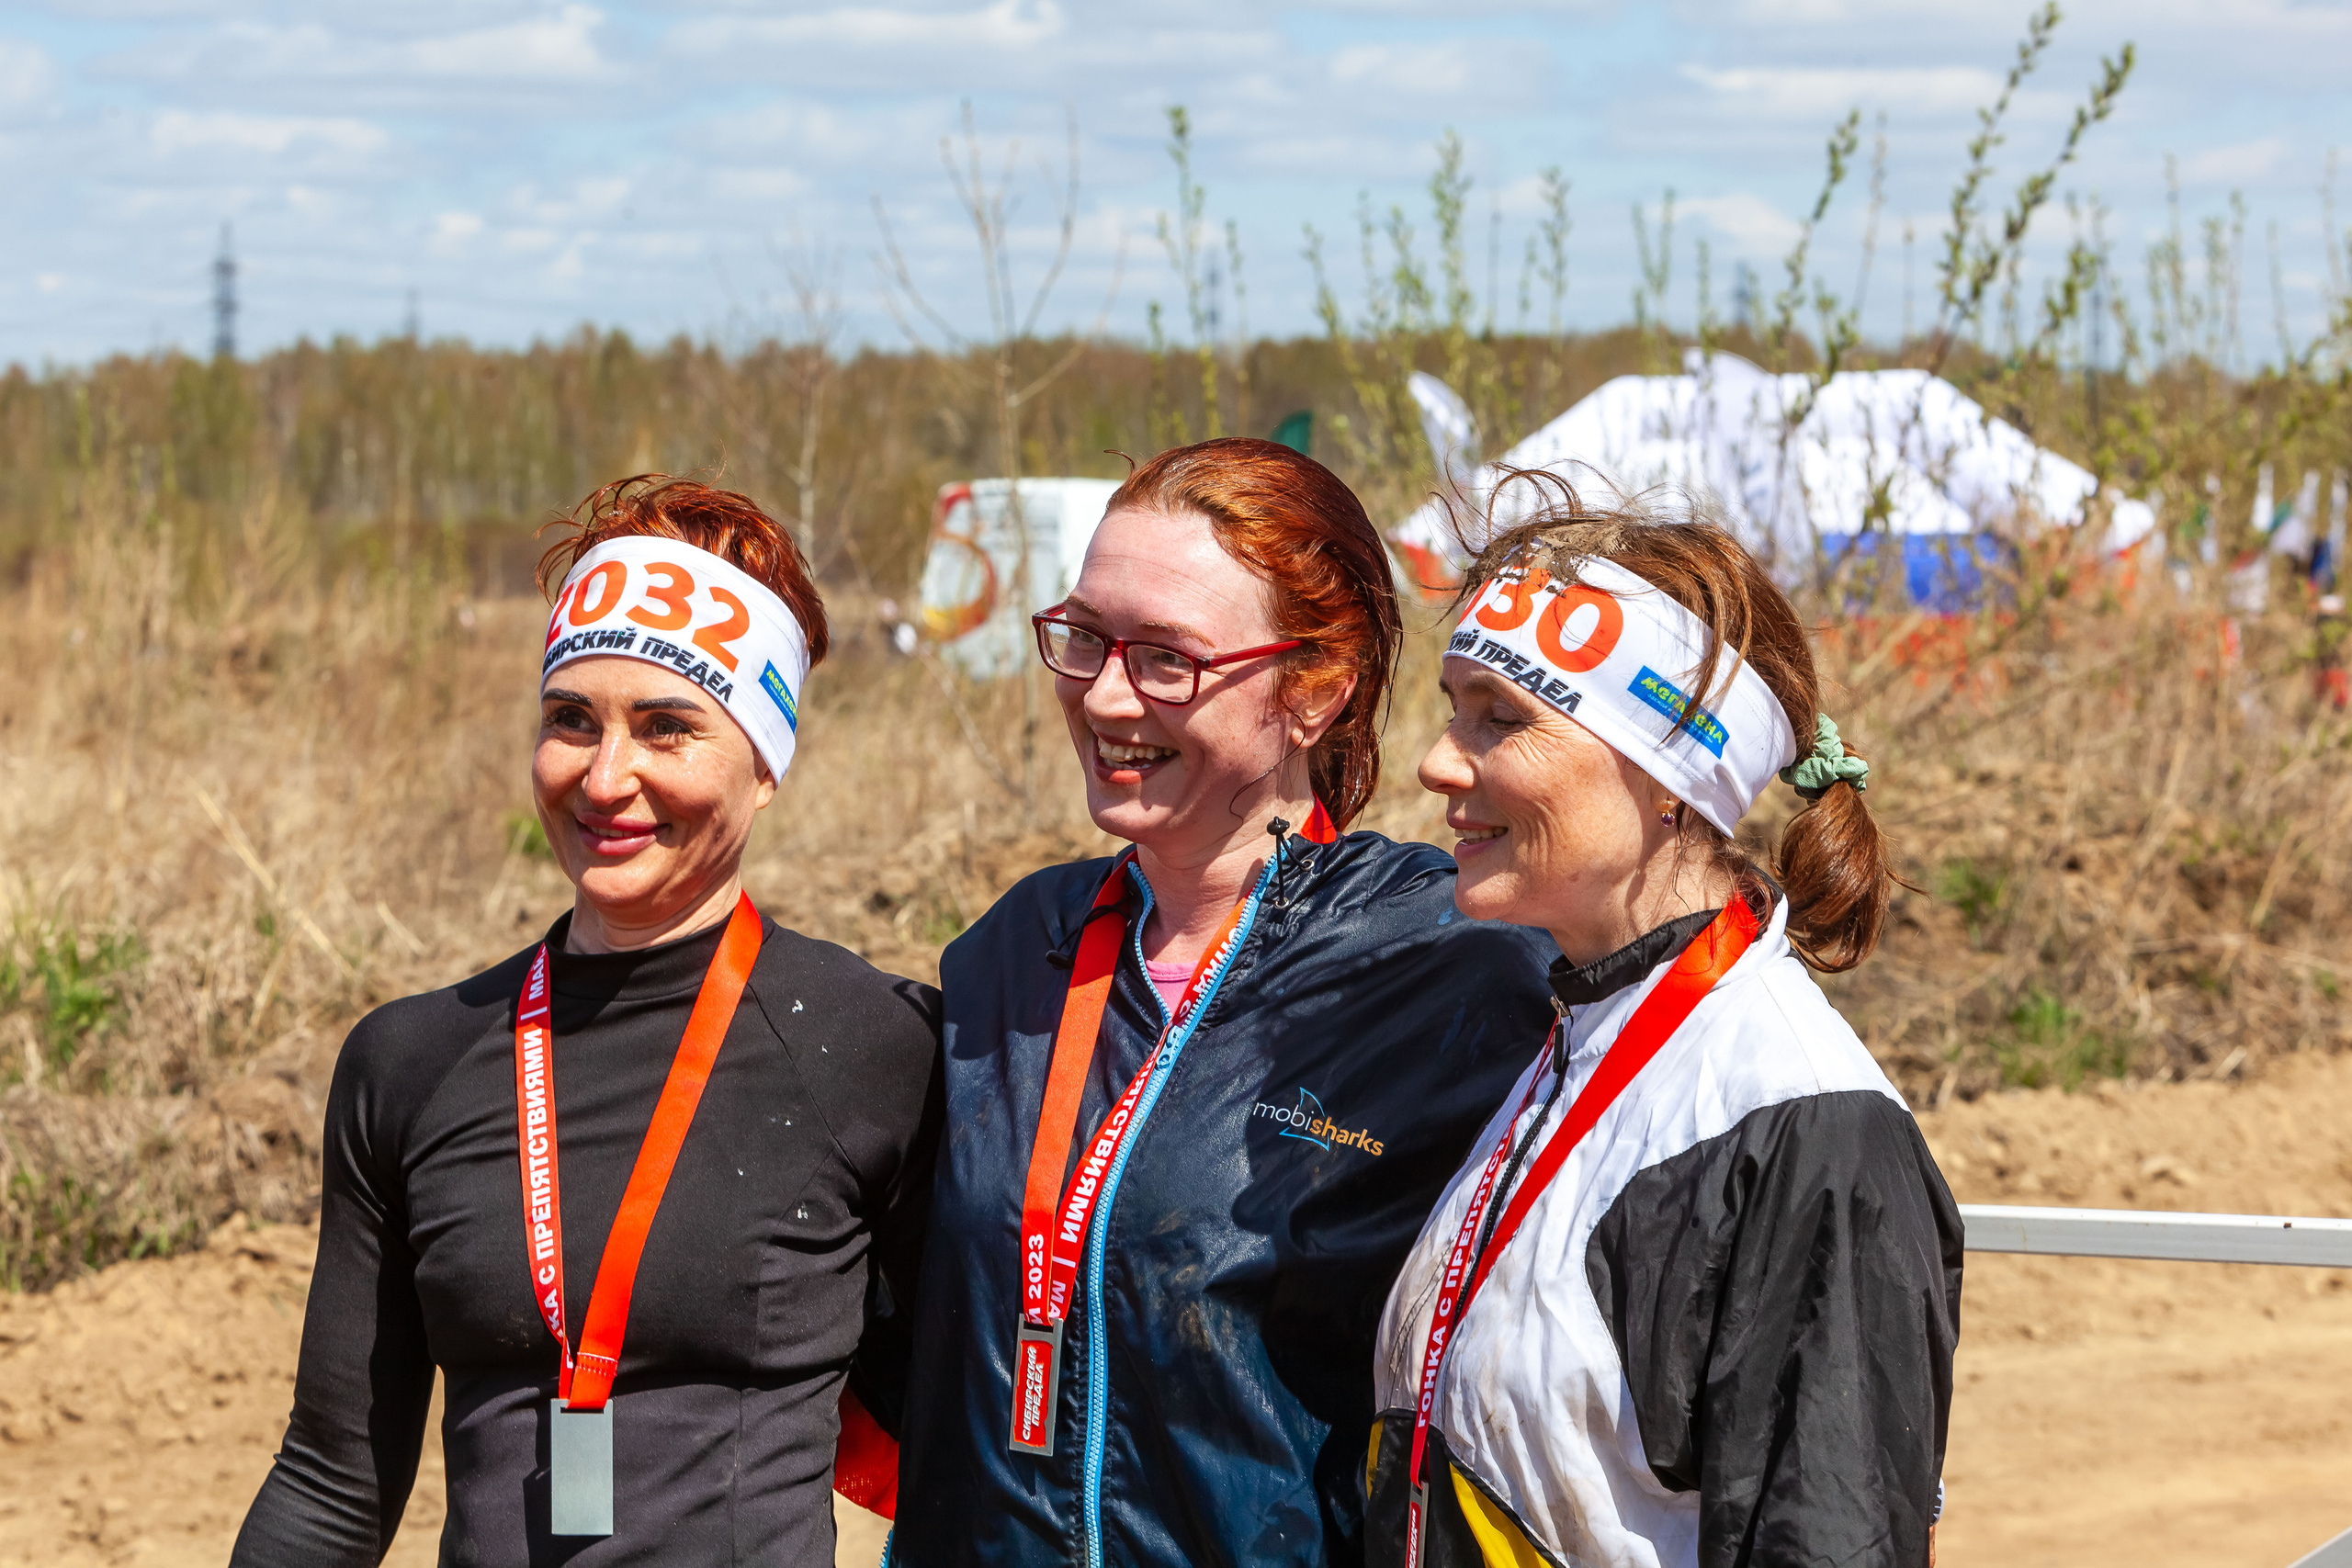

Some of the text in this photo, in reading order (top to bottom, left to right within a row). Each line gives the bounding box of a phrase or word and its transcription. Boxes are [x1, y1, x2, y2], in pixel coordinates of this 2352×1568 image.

[544, 560, 750, 673] 2032
[639, 637, 734, 704] ПРЕДЕЛ
[1473, 638, 1582, 714] ПРЕДЕЛ
[524, 1028, 554, 1261] ПРЕПЯТСТВИЯМИ
[1252, 1102, 1385, 1156] mobisharks
[1028, 1234, 1044, 1300] 2023
[1022, 1346, 1037, 1441] СИБИРСКИЙ
[1031, 1363, 1044, 1427] ПРЕДЕЛ
[1418, 1325, 1446, 1427] ГОНКА
[1439, 1296, 1452, 1315] С
